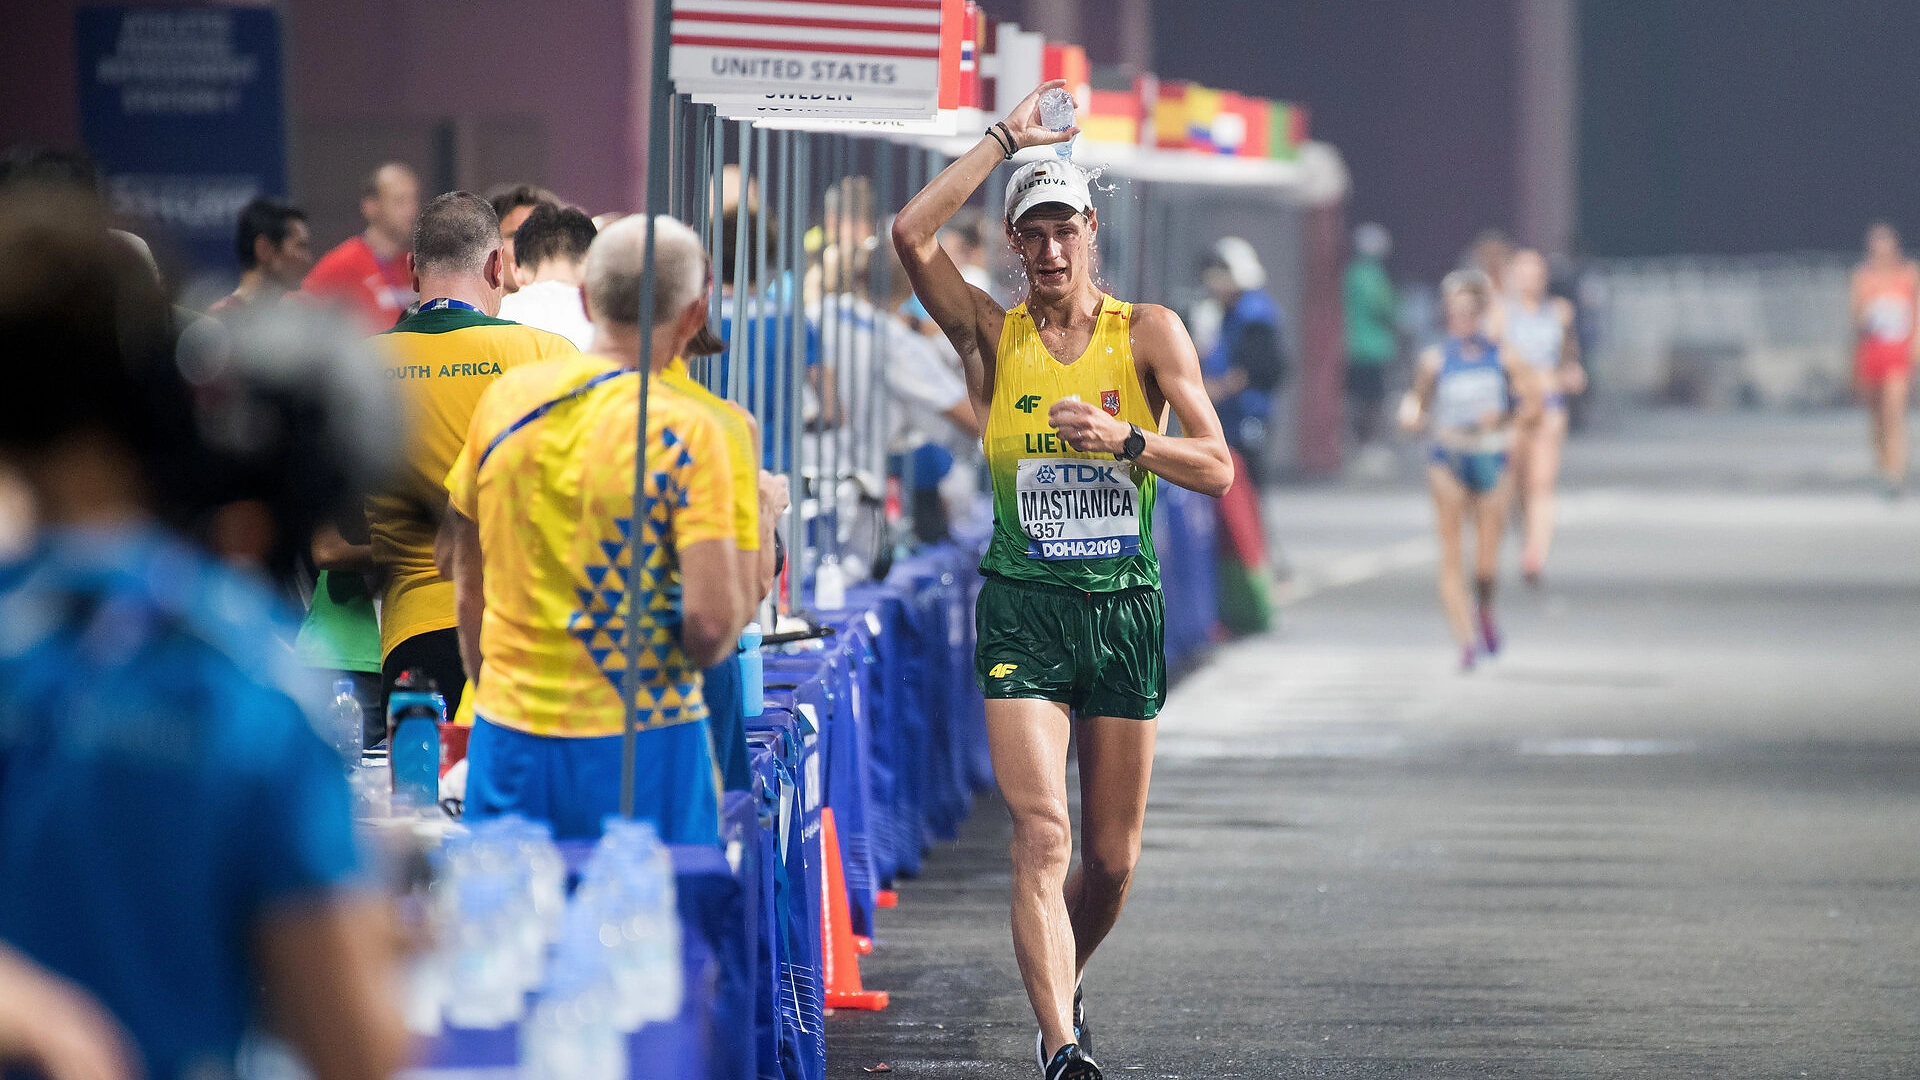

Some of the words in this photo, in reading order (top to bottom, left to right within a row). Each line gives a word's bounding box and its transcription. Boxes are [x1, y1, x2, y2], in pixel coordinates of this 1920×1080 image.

[711, 56, 802, 80] UNITED
[810, 60, 897, 84] STATES
[1018, 178, 1067, 193] LIETUVA
[384, 364, 431, 379] OUTH
[438, 361, 502, 378] AFRICA
[1014, 394, 1042, 414] 4F
[1055, 464, 1120, 484] TDK
[1021, 488, 1134, 521] MASTIANICA
[1025, 521, 1065, 539] 1357
[989, 662, 1018, 678] 4F
